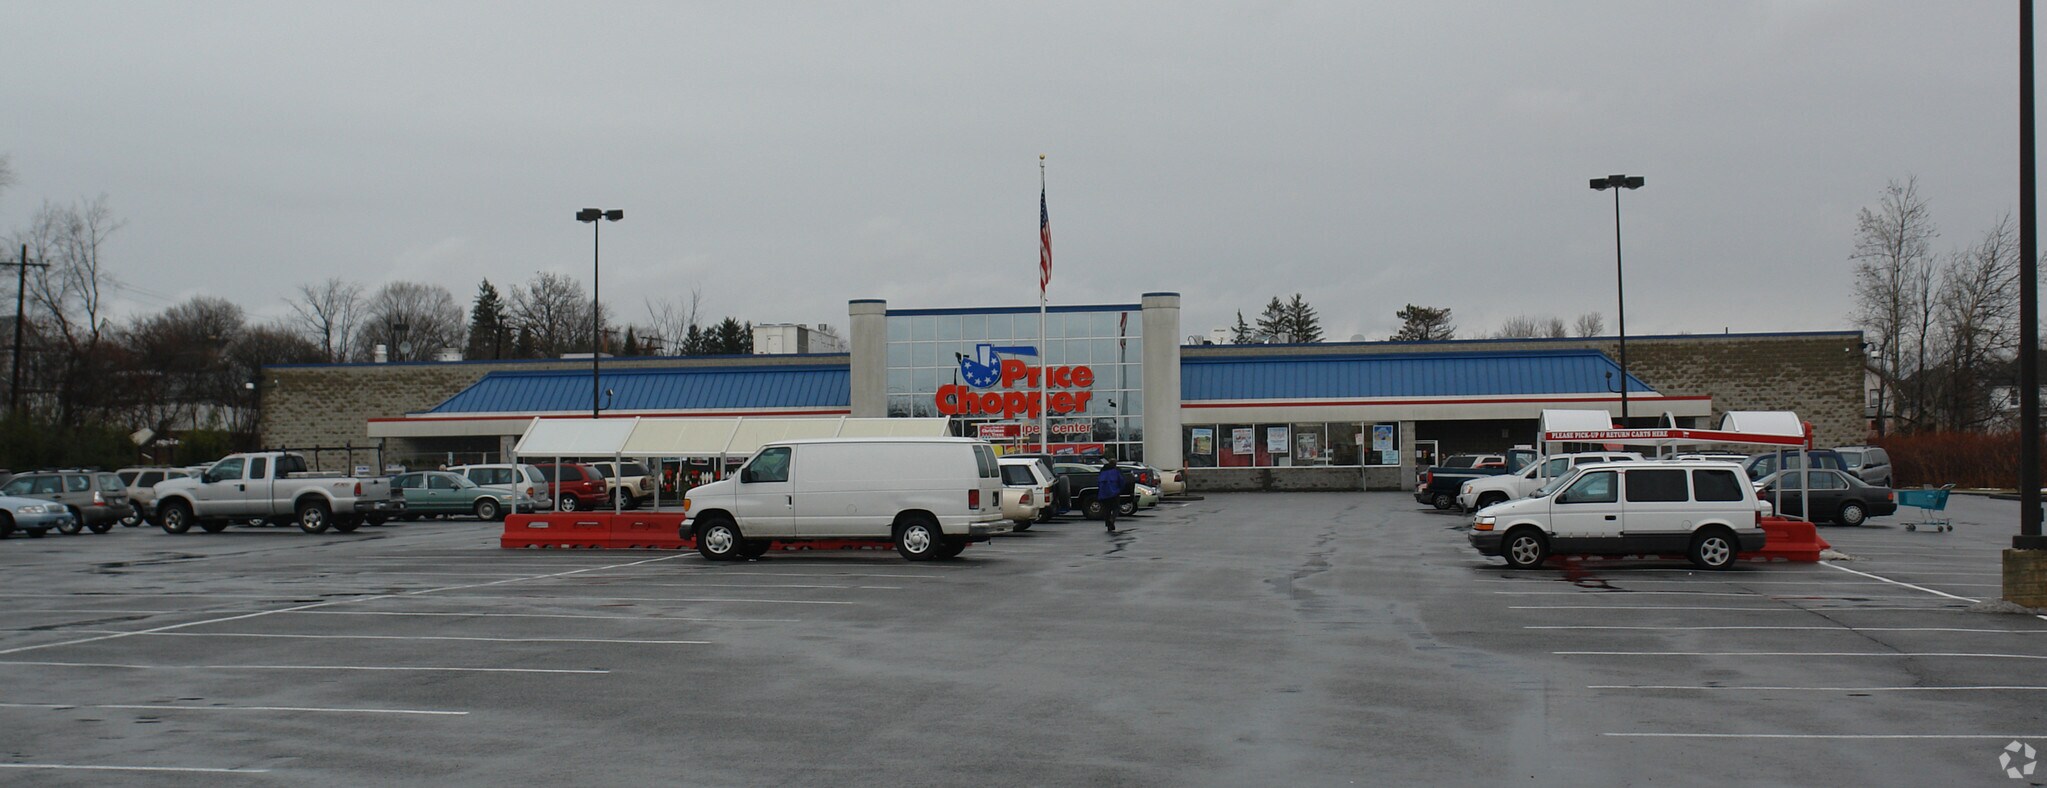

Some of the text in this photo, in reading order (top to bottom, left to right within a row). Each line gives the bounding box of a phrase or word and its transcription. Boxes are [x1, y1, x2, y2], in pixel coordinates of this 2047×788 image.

[1001, 359, 1094, 389] Price
[934, 383, 1092, 419] Chopper
[1052, 423, 1091, 434] center
[1574, 431, 1599, 439] PICK-UP
[1631, 430, 1651, 438] CARTS
